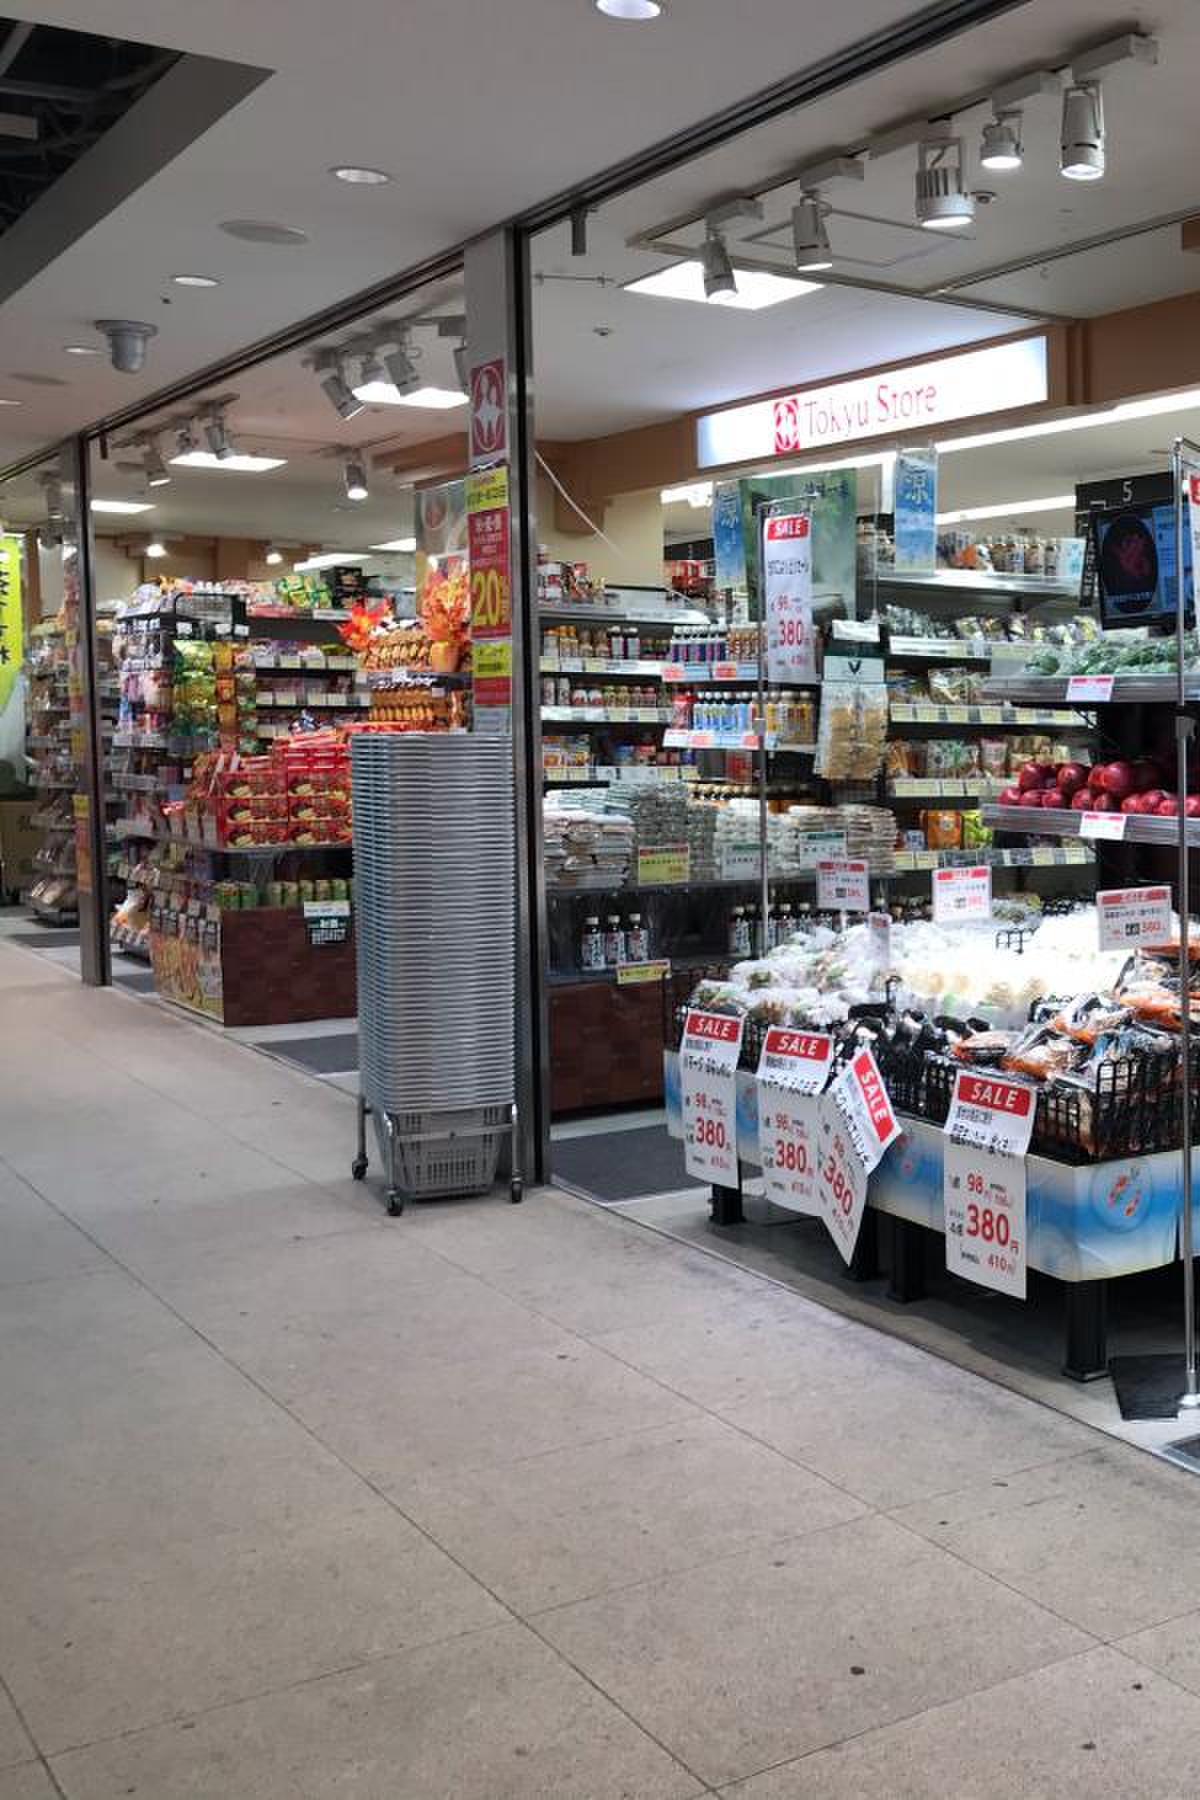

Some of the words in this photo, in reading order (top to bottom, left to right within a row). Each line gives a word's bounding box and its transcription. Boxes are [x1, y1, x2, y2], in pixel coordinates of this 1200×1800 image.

[804, 398, 868, 436] Tokyu
[876, 384, 938, 423] Store
[1122, 480, 1133, 502] 5
[773, 519, 802, 537] SALE
[695, 1017, 731, 1037] SALE
[778, 1034, 819, 1056] SALE
[859, 1069, 888, 1124] SALE
[970, 1082, 1019, 1110] SALE
